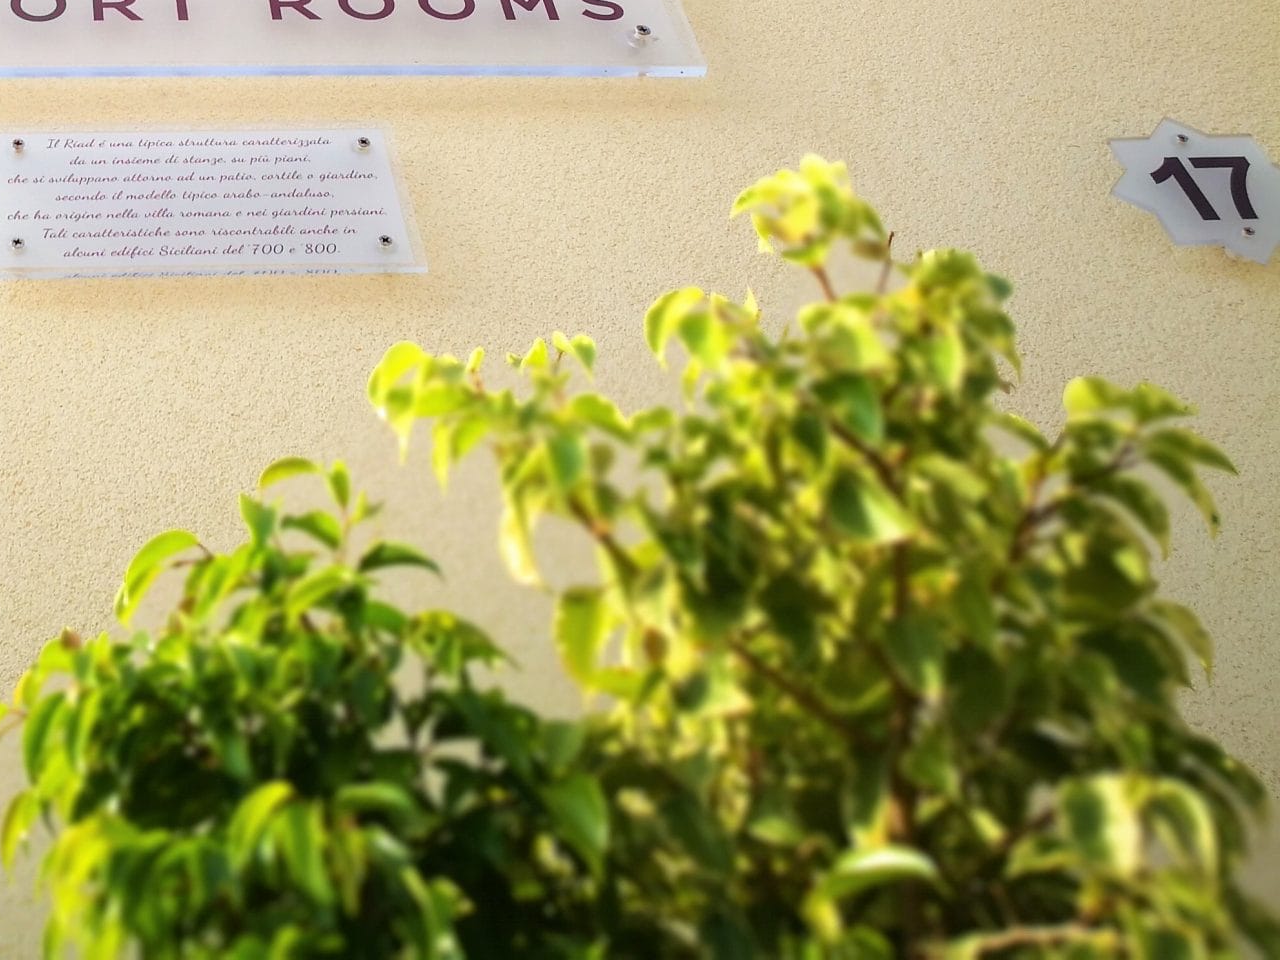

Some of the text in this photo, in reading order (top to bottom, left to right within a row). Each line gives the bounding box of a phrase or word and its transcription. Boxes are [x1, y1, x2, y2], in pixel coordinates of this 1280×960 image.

[46, 138, 59, 149] Il
[63, 139, 95, 149] Riad
[110, 141, 133, 149] una
[138, 139, 174, 151] tipica
[179, 138, 238, 147] struttura
[242, 137, 332, 149] caratterizzata
[69, 155, 86, 166] da
[112, 156, 161, 166] insieme
[164, 155, 179, 165] di
[231, 157, 246, 165] su
[249, 154, 270, 166] più
[7, 174, 29, 184] che
[32, 175, 46, 184] si
[48, 173, 119, 185] sviluppano
[122, 172, 172, 183] attorno
[177, 171, 195, 182] ad
[198, 174, 216, 182] un
[261, 170, 303, 181] cortile
[318, 170, 378, 182] giardino,
[55, 191, 106, 202] secondo
[111, 191, 122, 201] il
[126, 190, 177, 201] modello
[182, 190, 219, 202] tipico
[1149, 156, 1259, 221] 17
[7, 210, 29, 221] che
[33, 210, 52, 220] ha
[55, 211, 104, 223] origine
[106, 209, 141, 219] nella
[144, 208, 174, 219] villa
[179, 209, 232, 218] romana
[246, 208, 268, 217] nei
[271, 206, 327, 218] giardini
[42, 224, 359, 239] Tali caratteristiche sono riscontrabili anche in
[63, 247, 106, 258] alcuni
[110, 246, 155, 259] edifici
[158, 245, 218, 257] Siciliani
[222, 244, 245, 256] del
[288, 246, 297, 254] e
